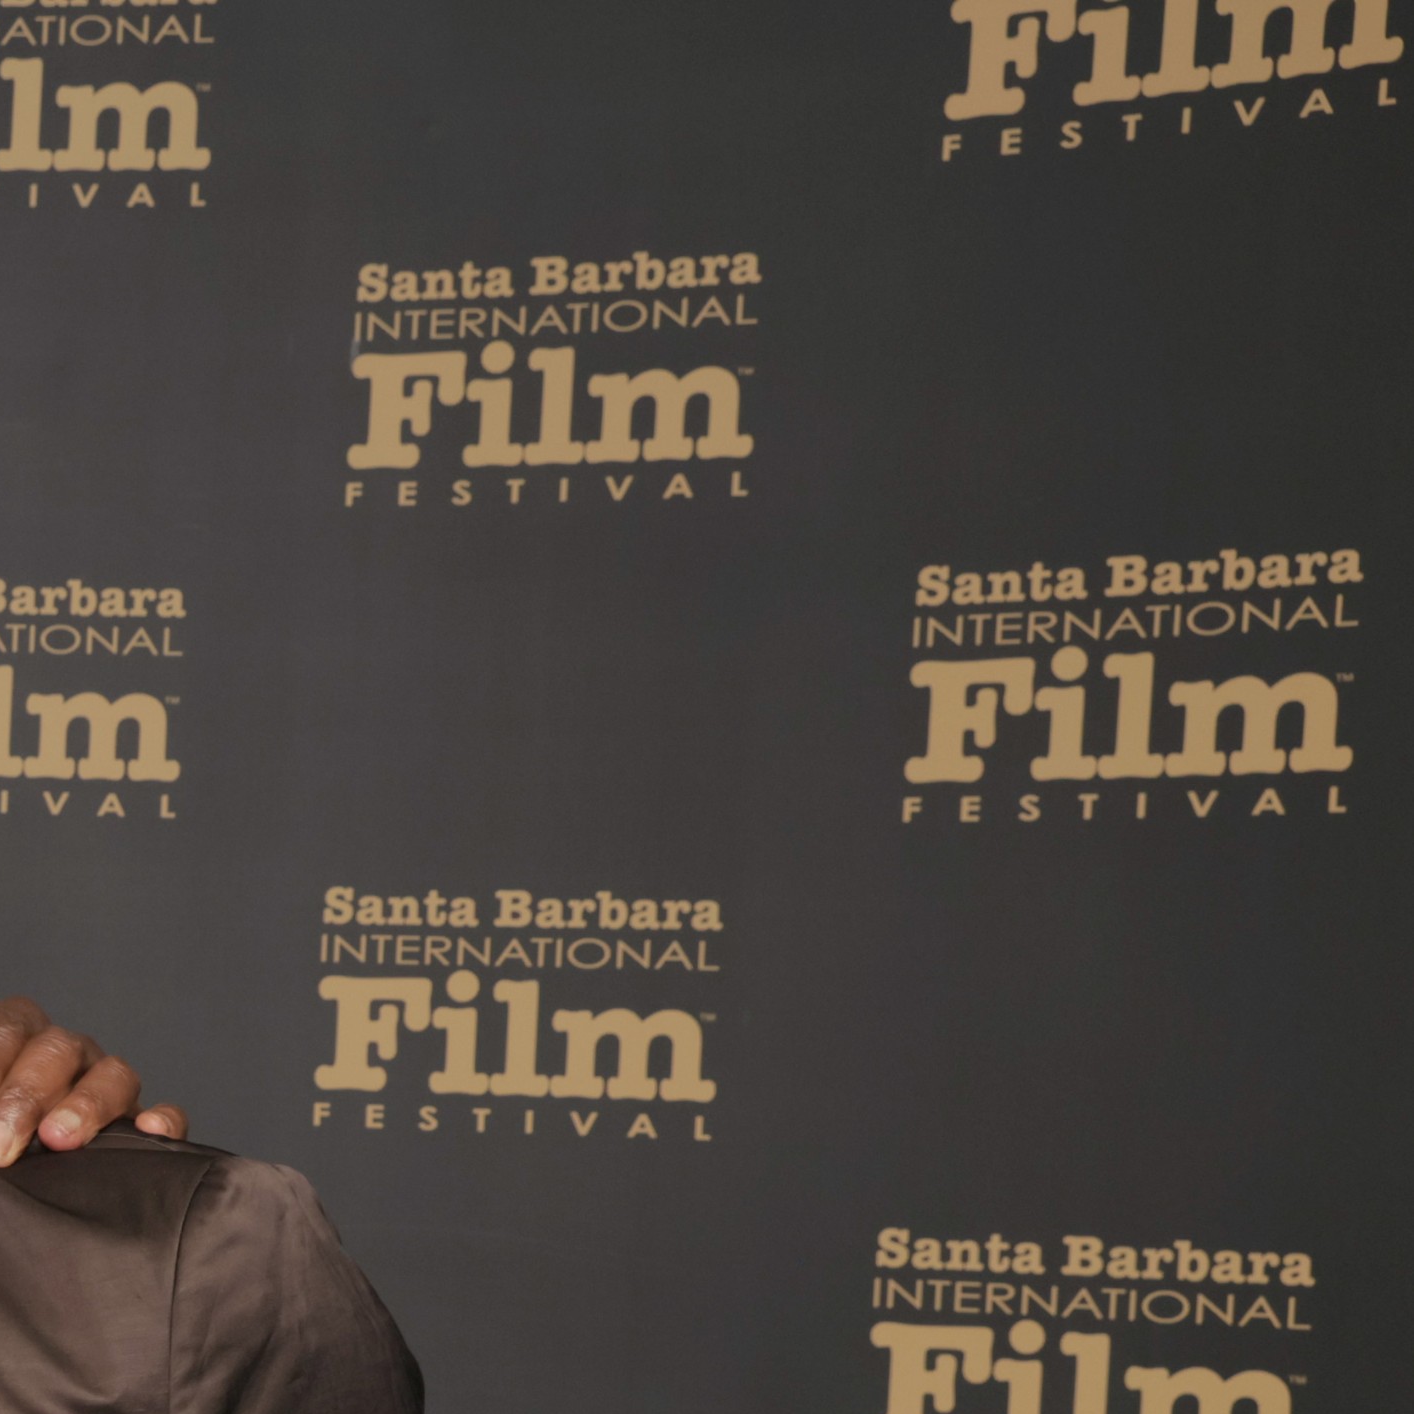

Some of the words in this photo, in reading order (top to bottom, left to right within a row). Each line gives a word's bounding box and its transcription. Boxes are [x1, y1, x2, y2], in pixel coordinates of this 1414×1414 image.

[943, 80, 1396, 160] FESTIVAL
[357, 262, 515, 302] Santa
[529, 252, 762, 295] Barbara
[355, 295, 756, 340] INTERNATIONAL
[347, 340, 754, 469] Film
[346, 472, 747, 506] FESTIVAL
[916, 562, 1088, 606] Santa
[1105, 549, 1364, 597] Barbara
[913, 595, 1357, 647] INTERNATIONAL
[904, 646, 1353, 784] Film
[903, 786, 1347, 822] FESTIVAL
[324, 887, 479, 928] Santa
[494, 890, 724, 931] Barbara
[321, 935, 718, 971] INTERNATIONAL
[314, 969, 717, 1102] Film
[313, 1102, 711, 1141] FESTIVAL
[876, 1228, 1044, 1275] Santa
[1061, 1235, 1316, 1287] Barbara
[873, 1279, 1310, 1330] INTERNATIONAL
